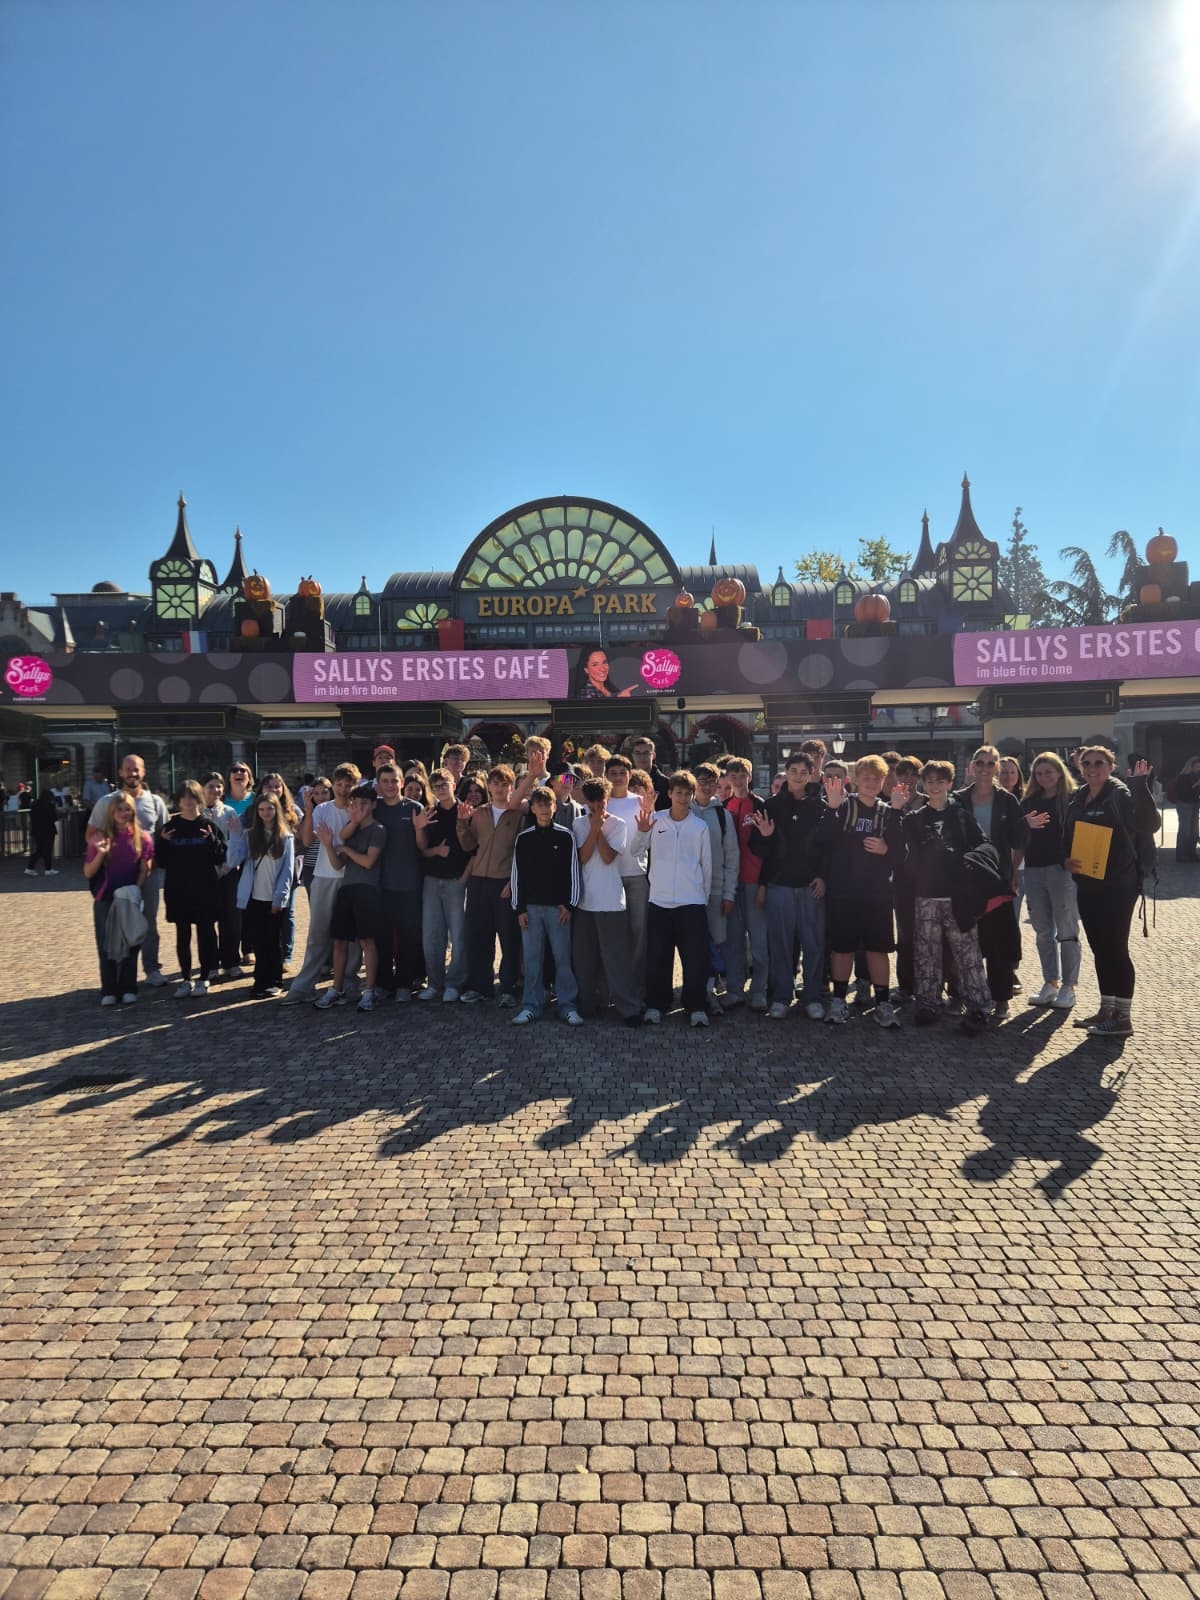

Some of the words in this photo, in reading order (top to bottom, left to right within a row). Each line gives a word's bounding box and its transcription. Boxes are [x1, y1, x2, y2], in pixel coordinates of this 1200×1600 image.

[478, 595, 575, 617] EUROPA
[593, 593, 657, 614] PARK
[976, 634, 1068, 664] SALLYS
[1079, 628, 1182, 658] ERSTES
[6, 657, 51, 684] Sallys
[314, 658, 393, 682] SALLYS
[402, 657, 485, 681] ERSTES
[494, 651, 550, 680] CAFÉ
[641, 651, 680, 677] Sallys
[976, 666, 990, 678] im
[993, 665, 1016, 677] blue
[1019, 664, 1038, 676] fire
[1041, 664, 1073, 676] Dome
[314, 685, 327, 696] im
[329, 685, 350, 696] blue
[352, 684, 368, 695] fire
[371, 684, 398, 695] Dome
